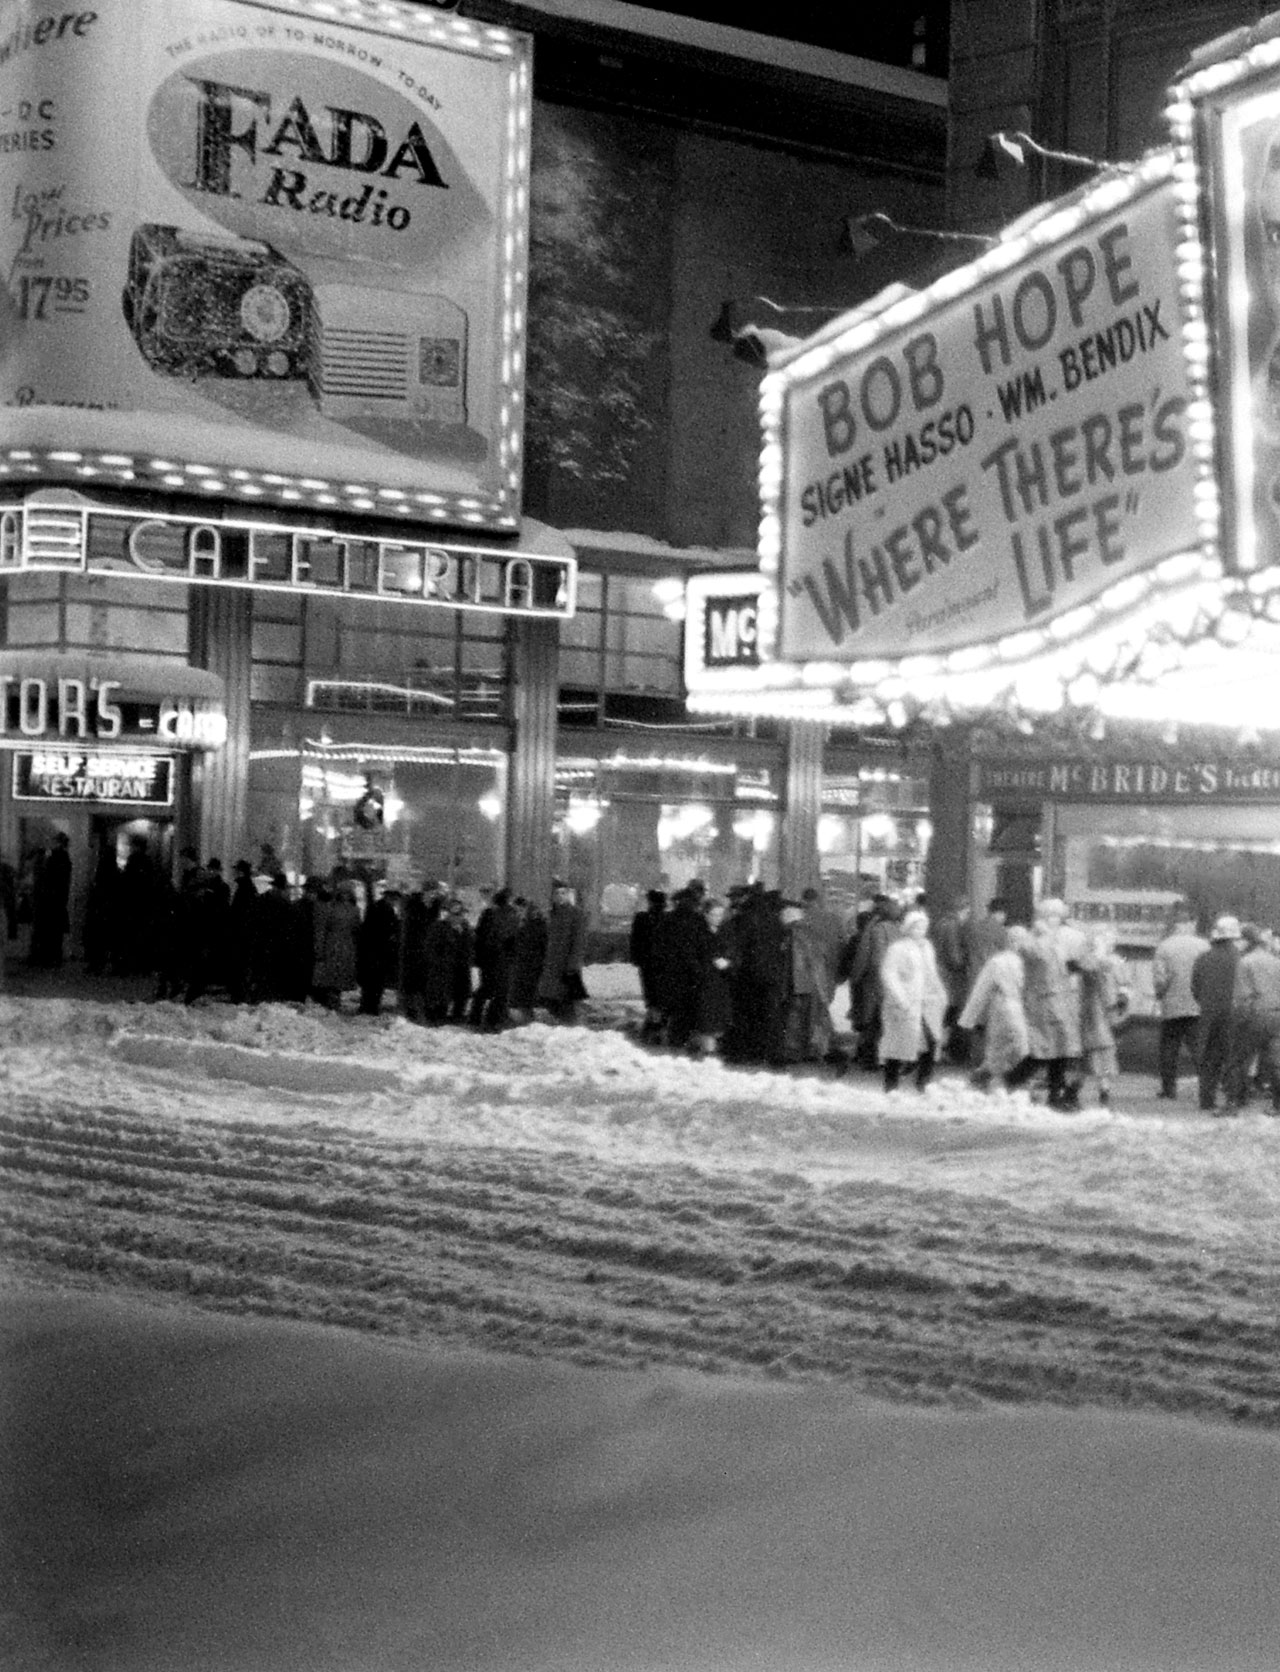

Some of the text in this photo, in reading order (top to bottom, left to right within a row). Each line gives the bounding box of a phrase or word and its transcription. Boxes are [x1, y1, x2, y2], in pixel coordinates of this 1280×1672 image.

[182, 75, 450, 200] FADA
[262, 166, 412, 232] Radio
[817, 224, 1140, 458] BOB HOPE
[800, 299, 1170, 528] SIGNE HASSO WM. BENDIX
[980, 388, 1188, 523] THERE'S
[129, 519, 536, 609] CAFETERIA
